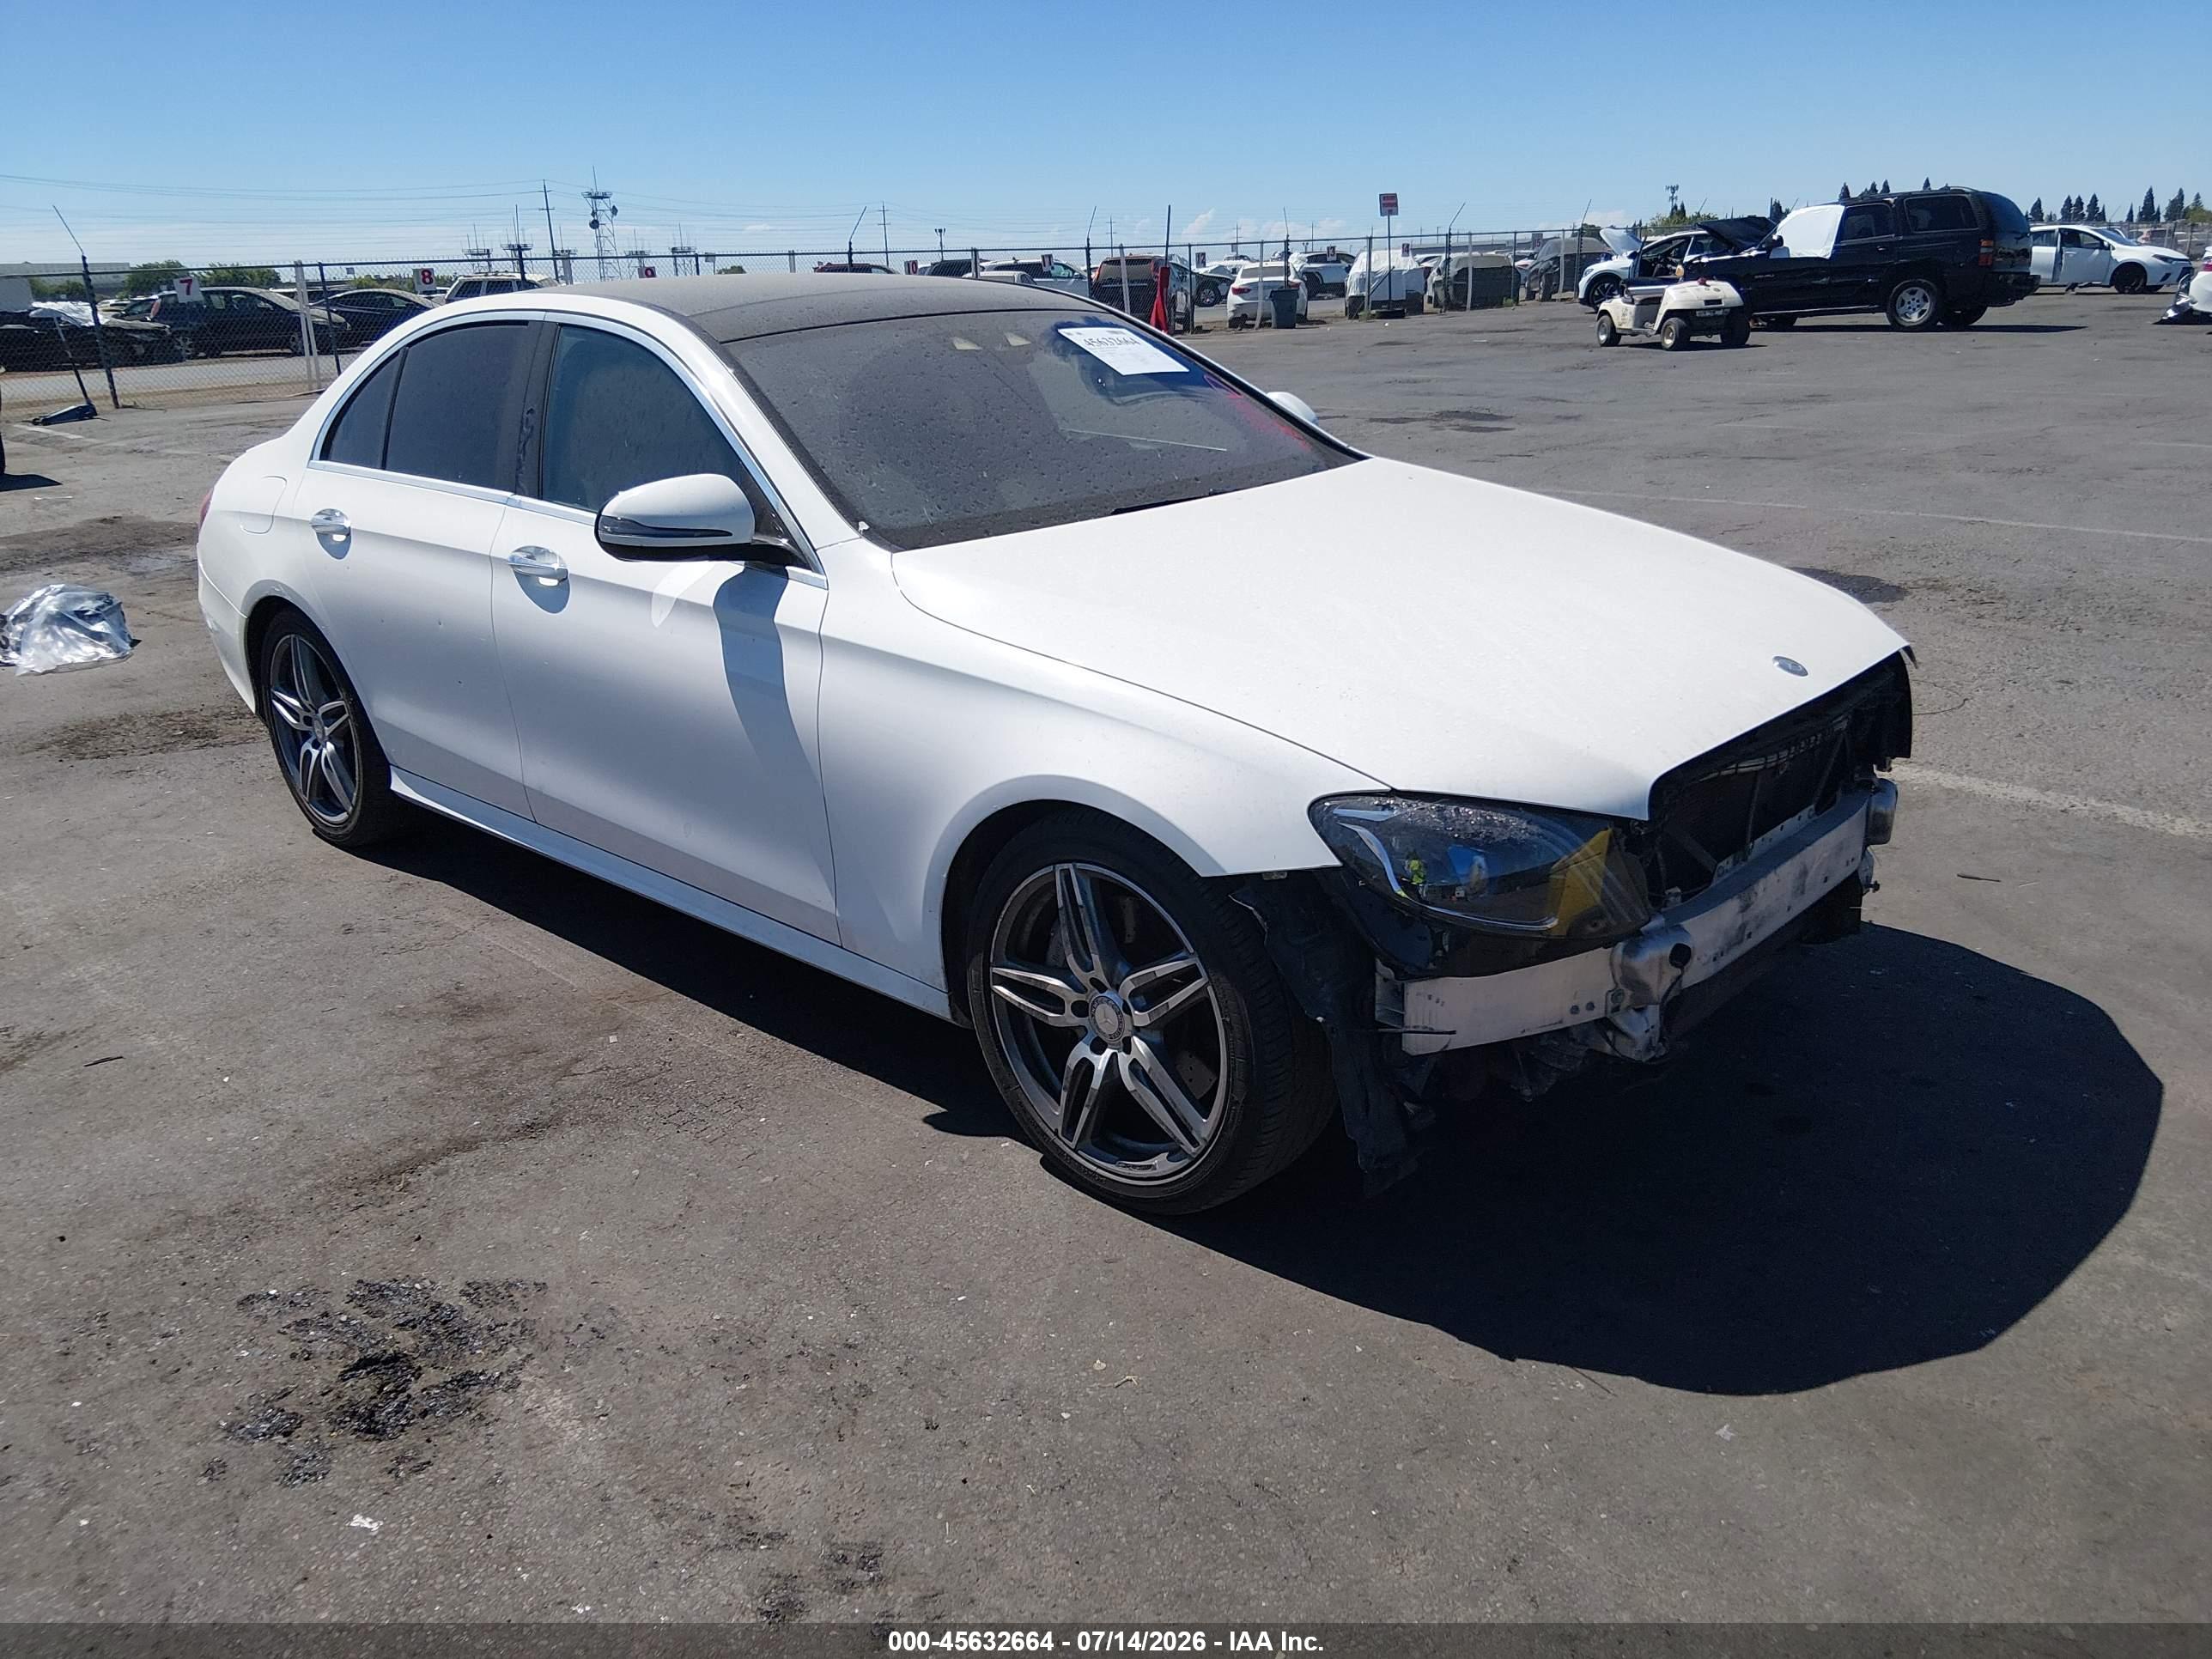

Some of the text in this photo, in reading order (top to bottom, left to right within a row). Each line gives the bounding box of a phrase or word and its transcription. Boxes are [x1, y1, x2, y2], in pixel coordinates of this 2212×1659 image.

[421, 269, 434, 285] 8
[179, 278, 193, 296] 7
[1083, 337, 1141, 348] 45632664
